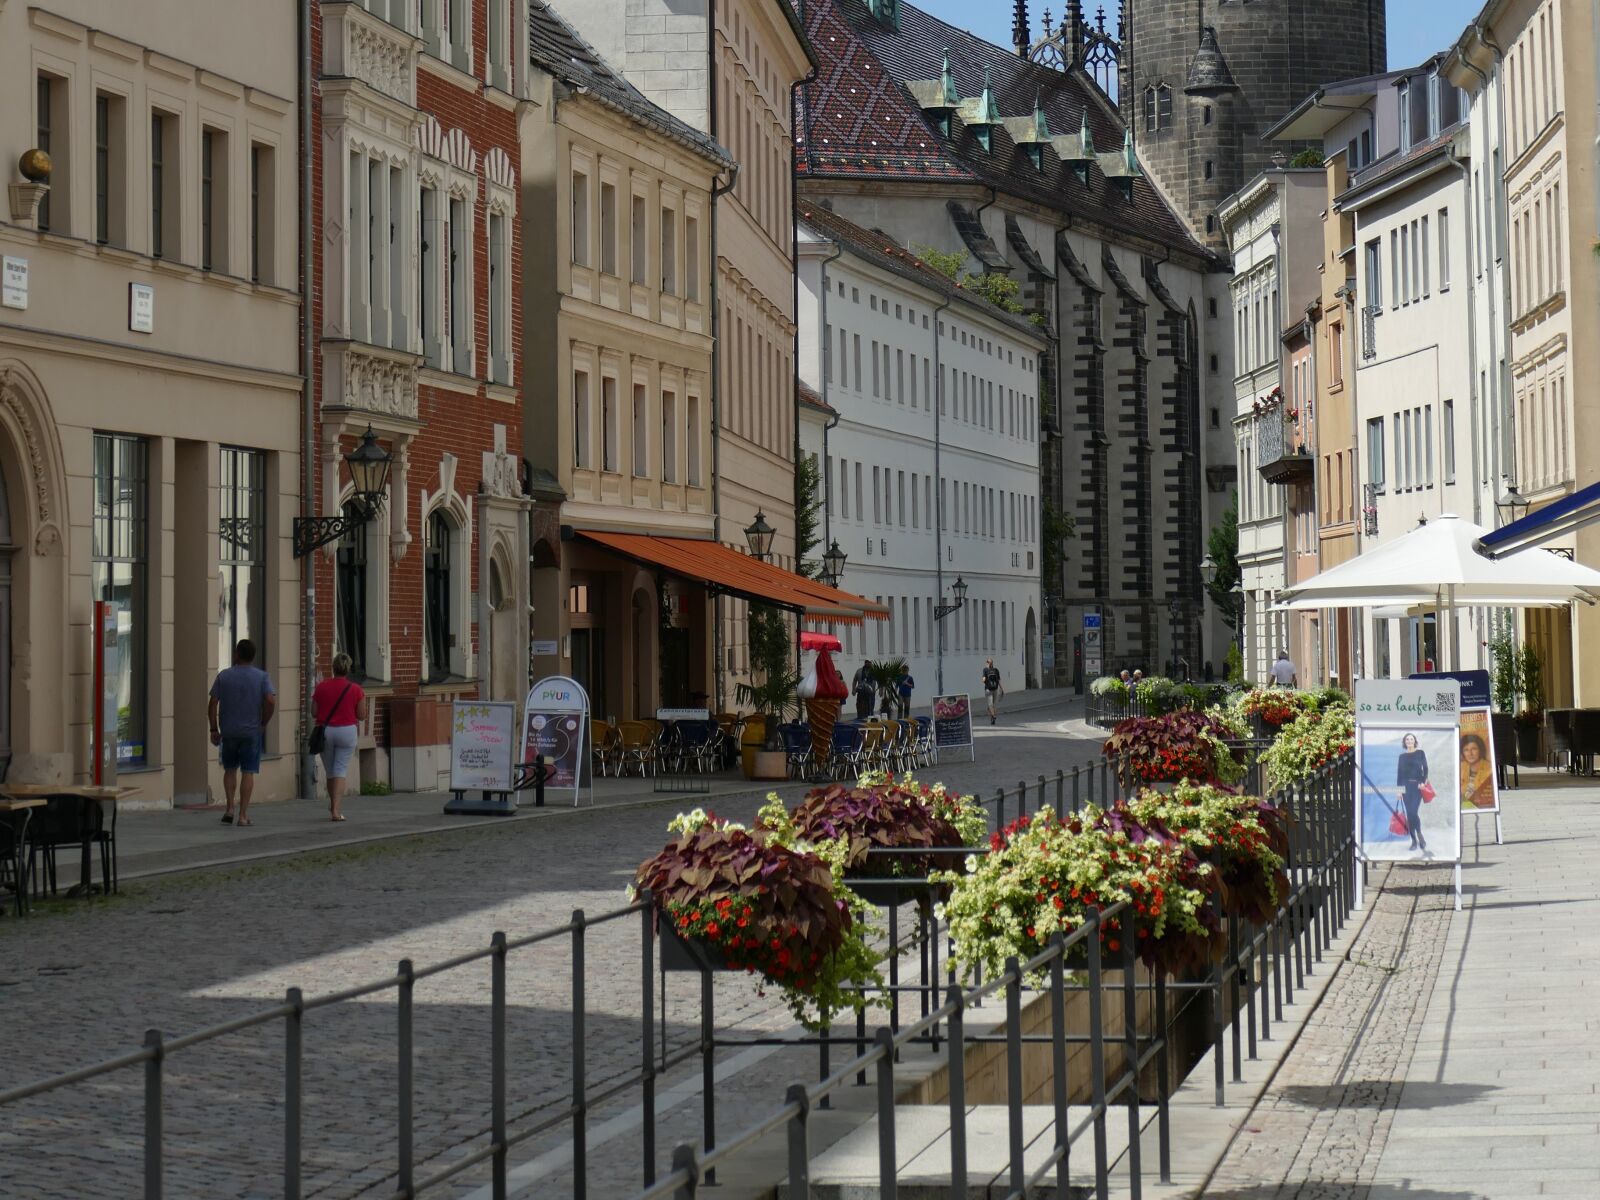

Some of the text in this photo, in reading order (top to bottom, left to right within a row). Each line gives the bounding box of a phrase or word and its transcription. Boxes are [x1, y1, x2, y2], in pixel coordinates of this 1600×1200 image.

[1359, 703, 1372, 712] so
[1376, 703, 1392, 712] zu
[1395, 695, 1437, 716] laufen
